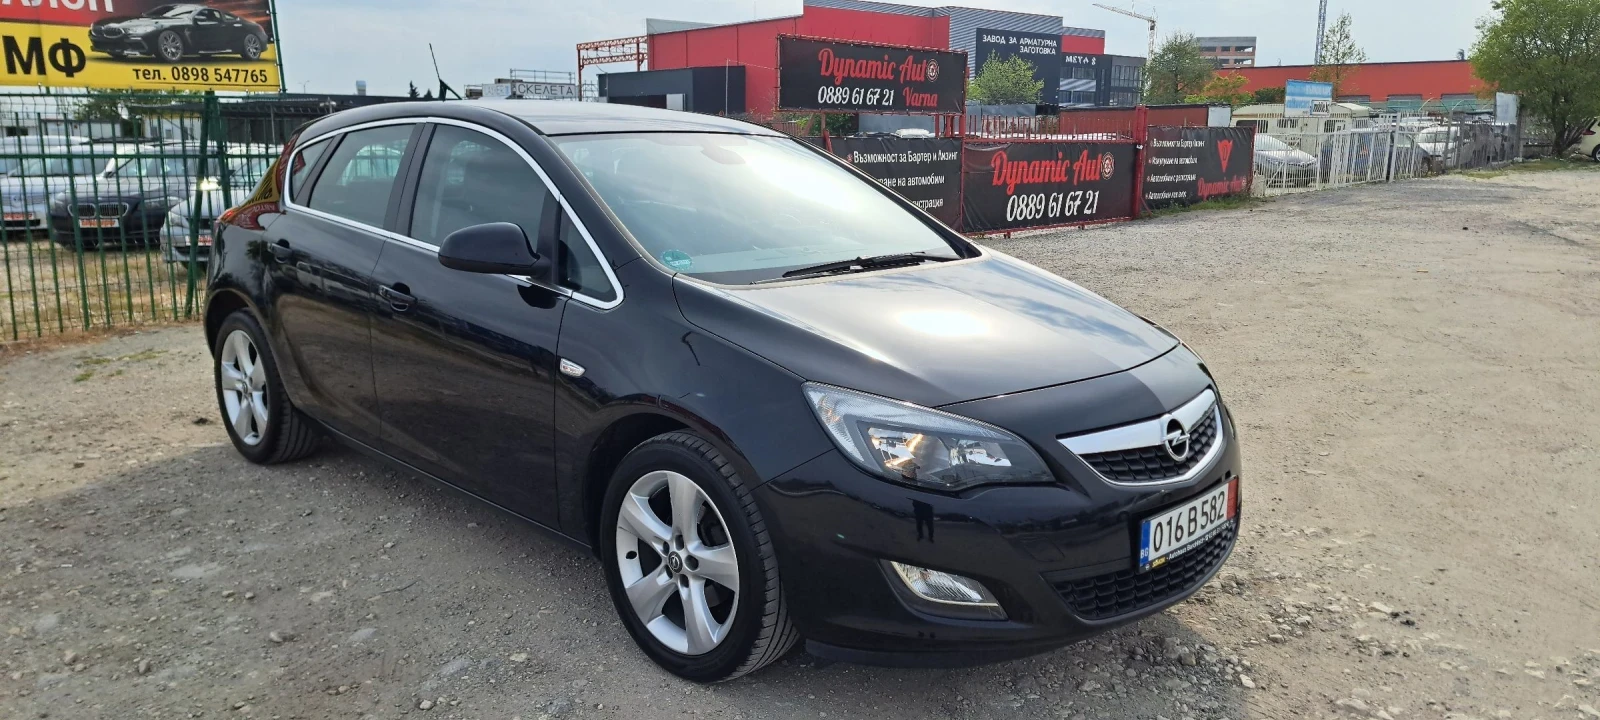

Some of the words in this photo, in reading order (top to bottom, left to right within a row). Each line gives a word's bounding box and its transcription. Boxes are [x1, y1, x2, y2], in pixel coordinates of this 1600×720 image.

[982, 34, 1006, 45] ЗАВОД
[1008, 36, 1018, 44] ЗА
[1019, 37, 1058, 47] АРМАТУРНА
[2, 35, 87, 78] МФ
[1019, 46, 1056, 55] ЗАГОТОВКА
[132, 68, 167, 81] тел.
[171, 66, 210, 82] 0898
[214, 67, 268, 83] 547765
[818, 48, 896, 86] Dynamic
[517, 83, 574, 96] СКЕЛЕТА
[817, 86, 850, 104] 0889
[852, 87, 865, 105] 61
[866, 88, 881, 105] 67
[882, 89, 895, 106] 21
[902, 86, 938, 107] Varna
[853, 150, 898, 163] Възможност
[899, 153, 908, 162] за
[907, 150, 932, 164] Бартер
[932, 153, 937, 161] и
[937, 149, 958, 161] Лизинг
[897, 177, 906, 187] на
[907, 172, 945, 186] автомобили
[990, 150, 1070, 196] Dynamic
[1006, 193, 1046, 222] 0889
[1048, 192, 1064, 218] 61
[1065, 190, 1083, 217] 67
[1084, 189, 1100, 215] 21
[1140, 547, 1149, 559] BG
